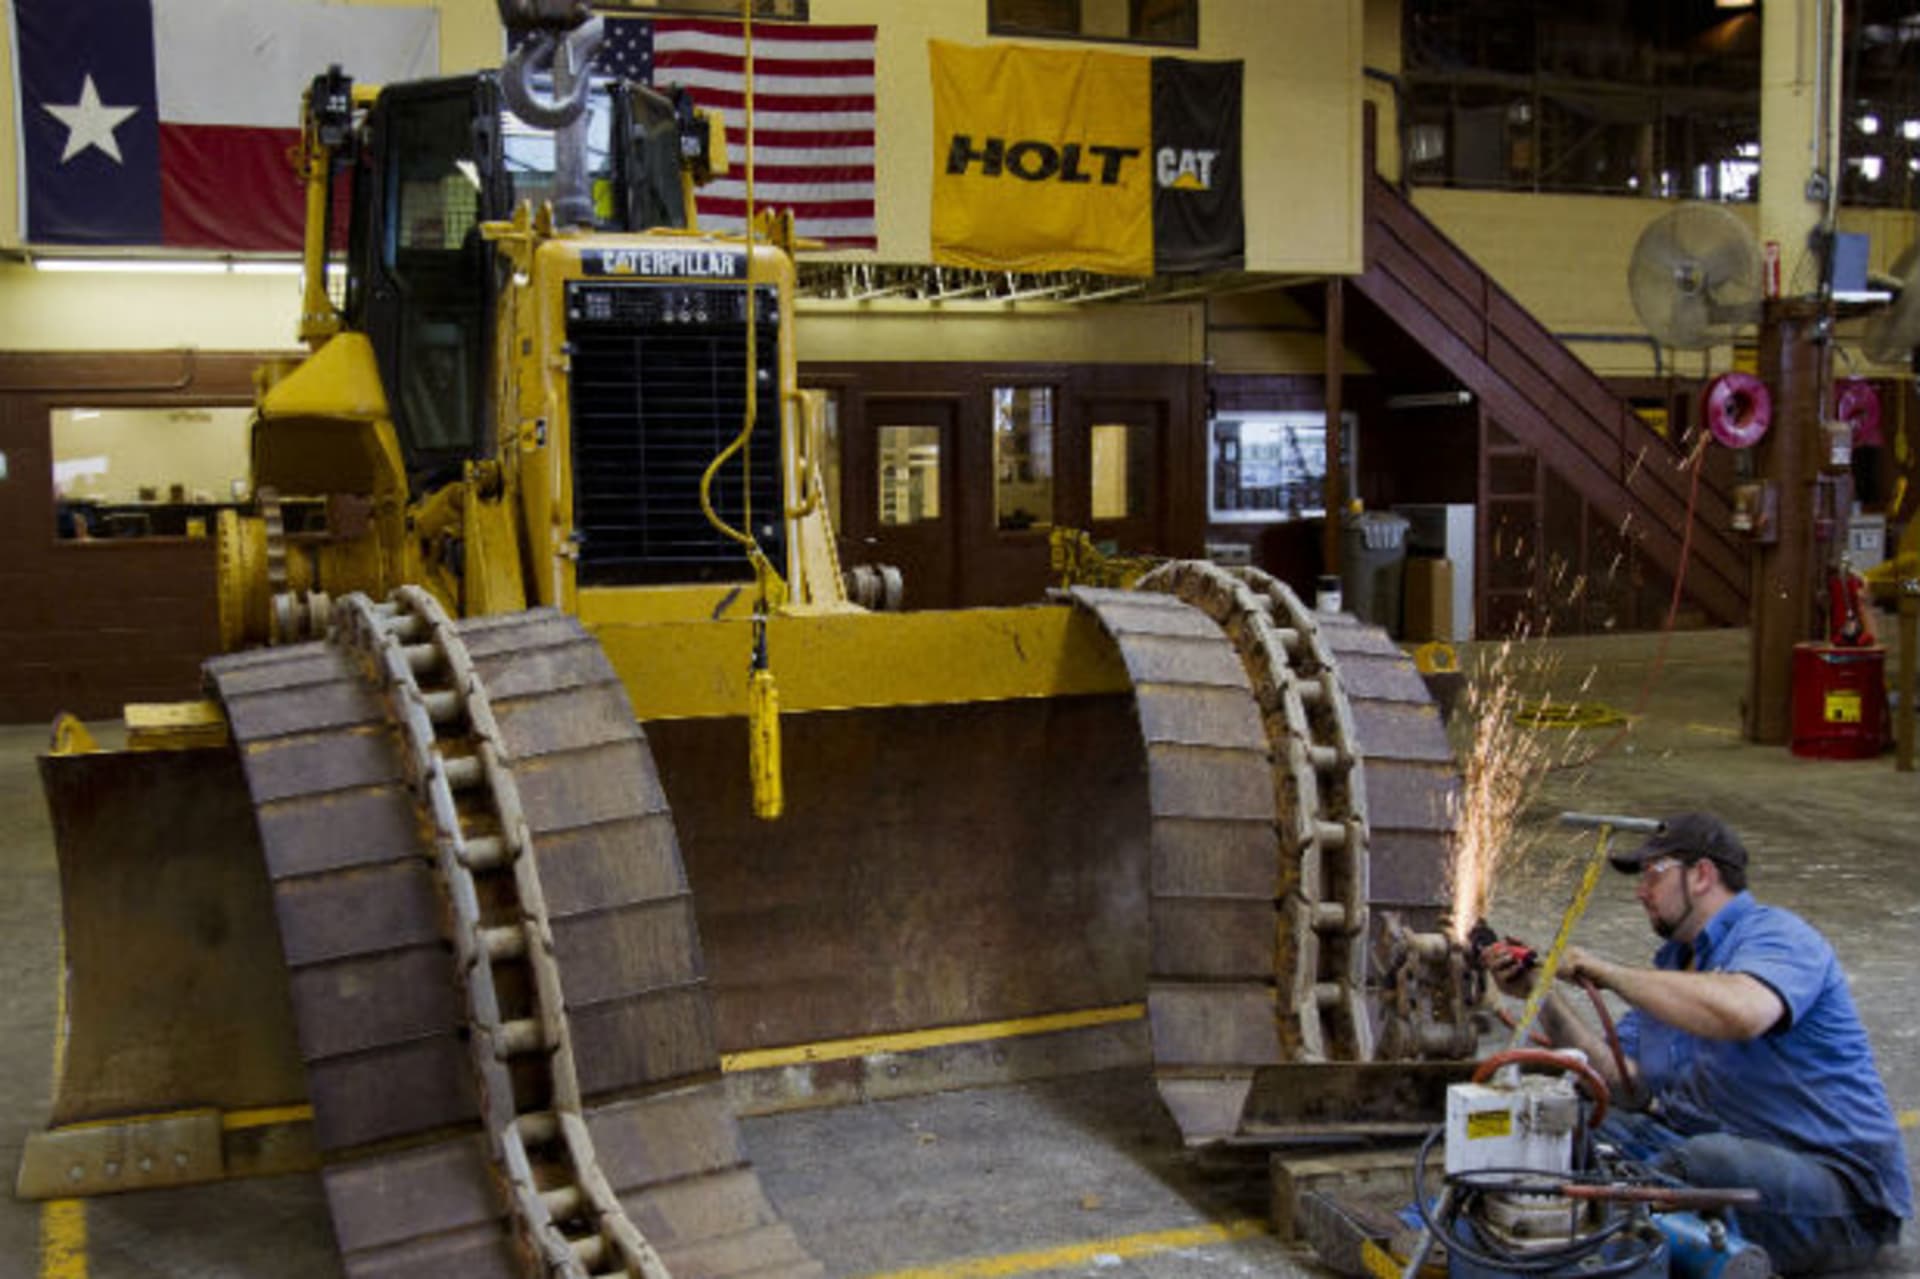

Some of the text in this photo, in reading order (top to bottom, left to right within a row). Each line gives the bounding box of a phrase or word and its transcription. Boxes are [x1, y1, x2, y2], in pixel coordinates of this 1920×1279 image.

[946, 134, 1216, 190] HOLT CAT
[602, 250, 735, 275] CATERPILLAR
